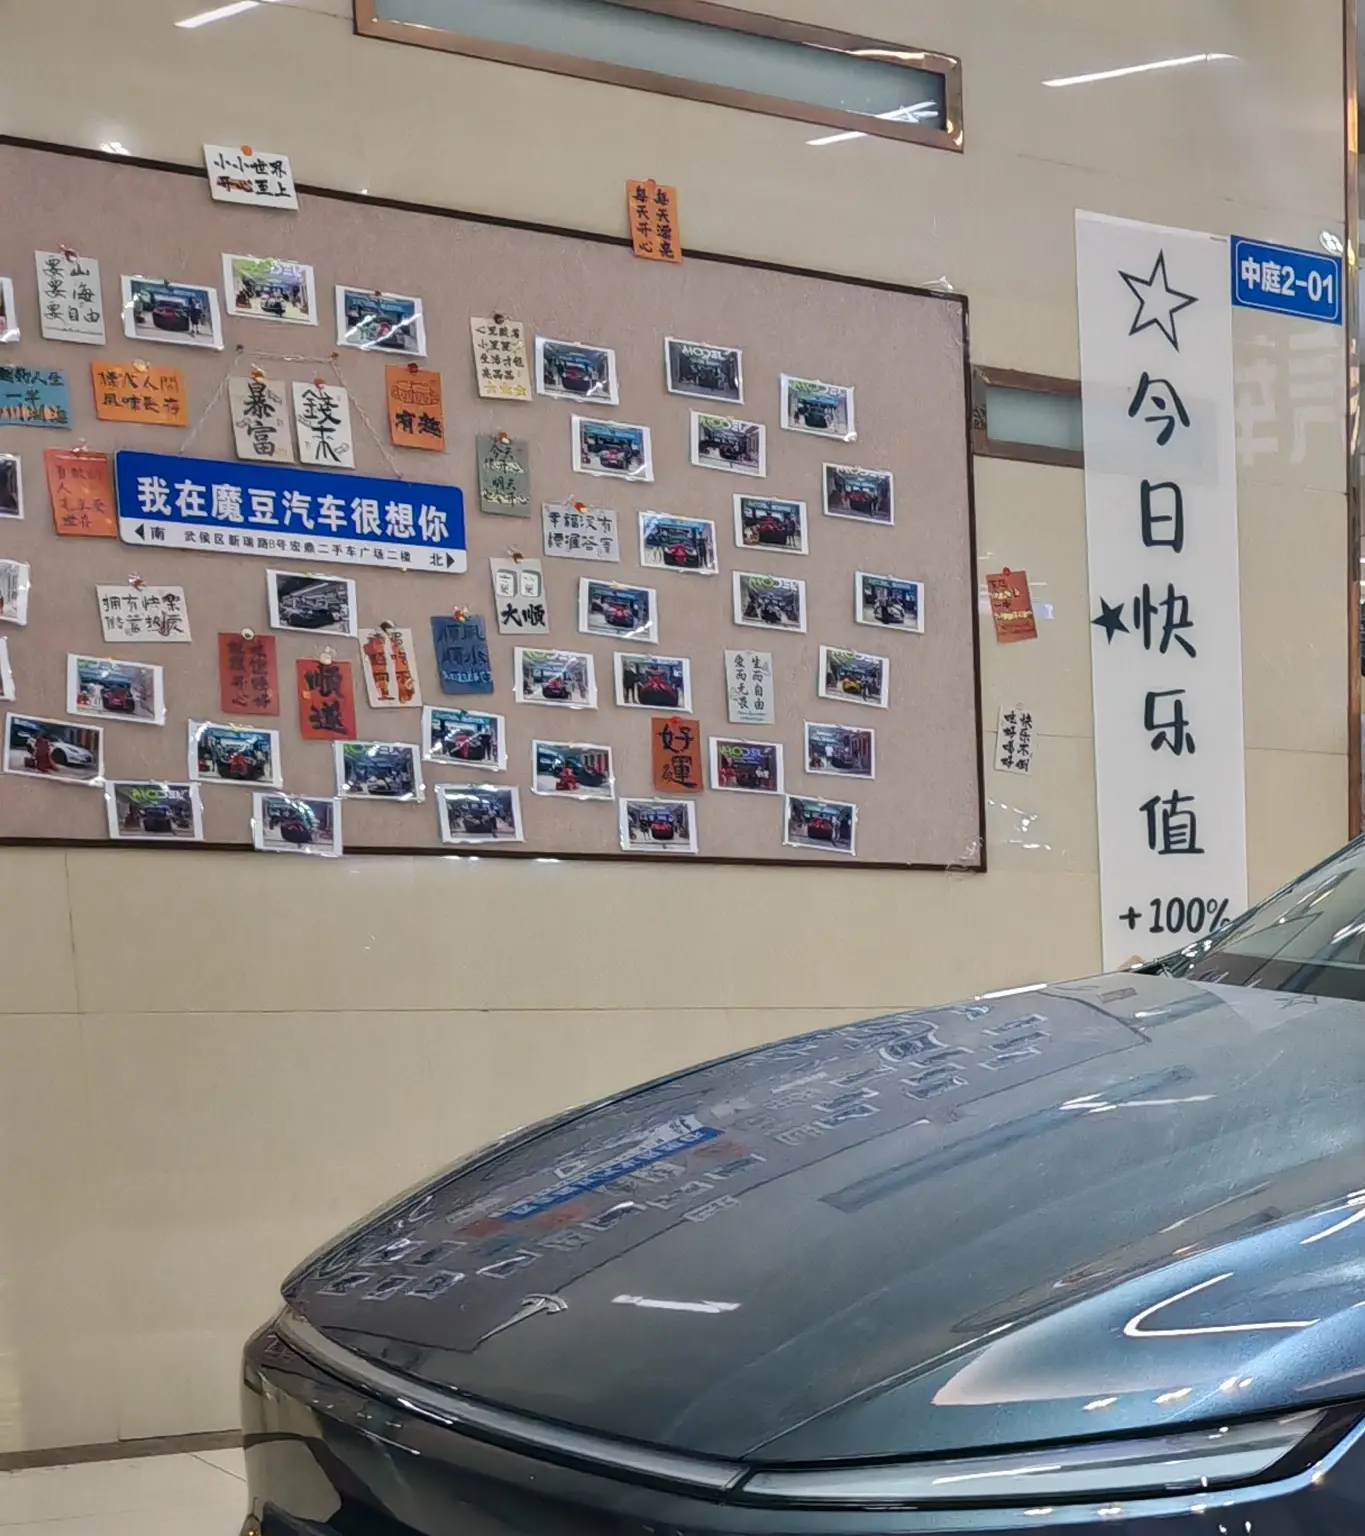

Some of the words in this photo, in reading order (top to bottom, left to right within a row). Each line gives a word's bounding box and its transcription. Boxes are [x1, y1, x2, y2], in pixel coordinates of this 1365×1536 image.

[1240, 256, 1335, 306] 中庭2-01
[137, 474, 450, 543] 我在魔豆汽车很想你
[150, 525, 166, 543] 南
[429, 552, 445, 568] 北
[1129, 371, 1205, 856] 今日快乐值
[1119, 895, 1231, 935] +100%
